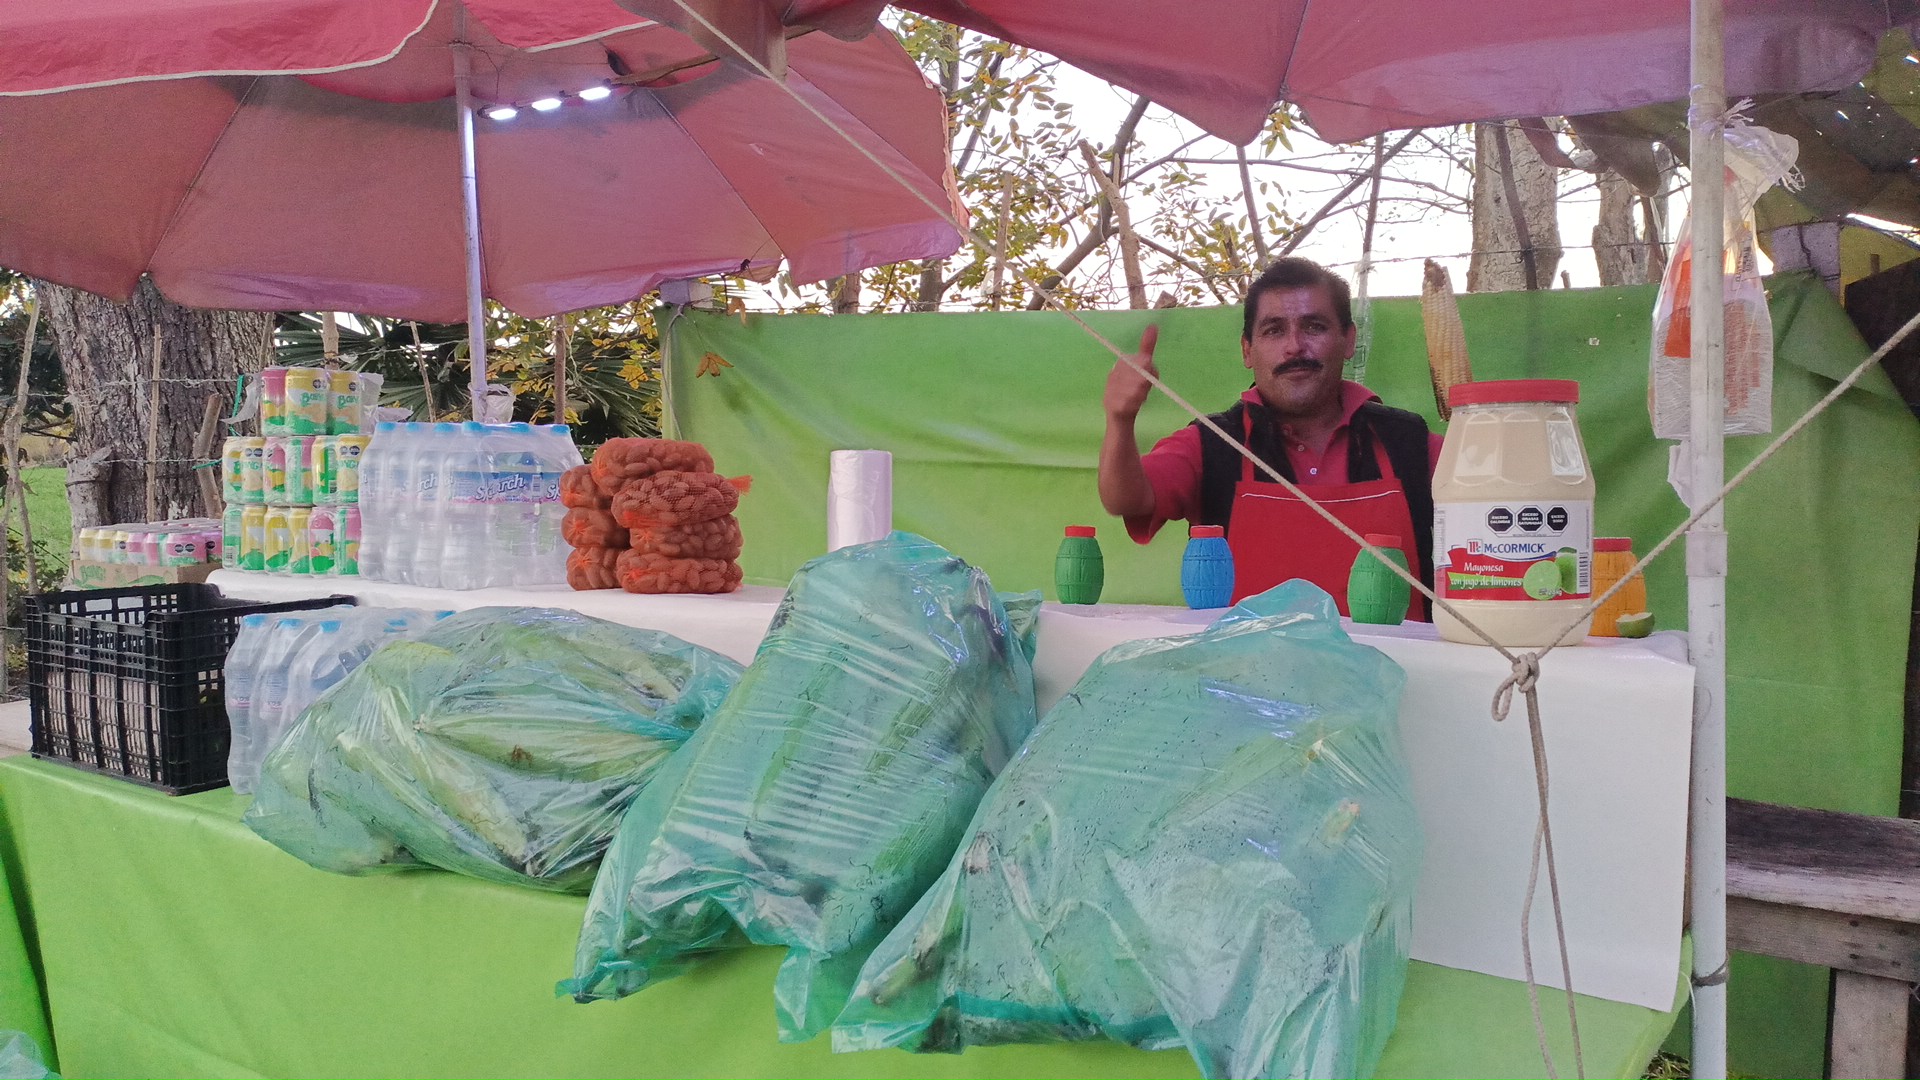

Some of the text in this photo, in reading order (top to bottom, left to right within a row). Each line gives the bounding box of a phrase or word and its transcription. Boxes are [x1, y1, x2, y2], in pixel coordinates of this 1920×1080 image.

[1485, 543, 1545, 553] McCORMICK
[1463, 562, 1504, 575] Mayonesa
[1491, 575, 1522, 586] limones
